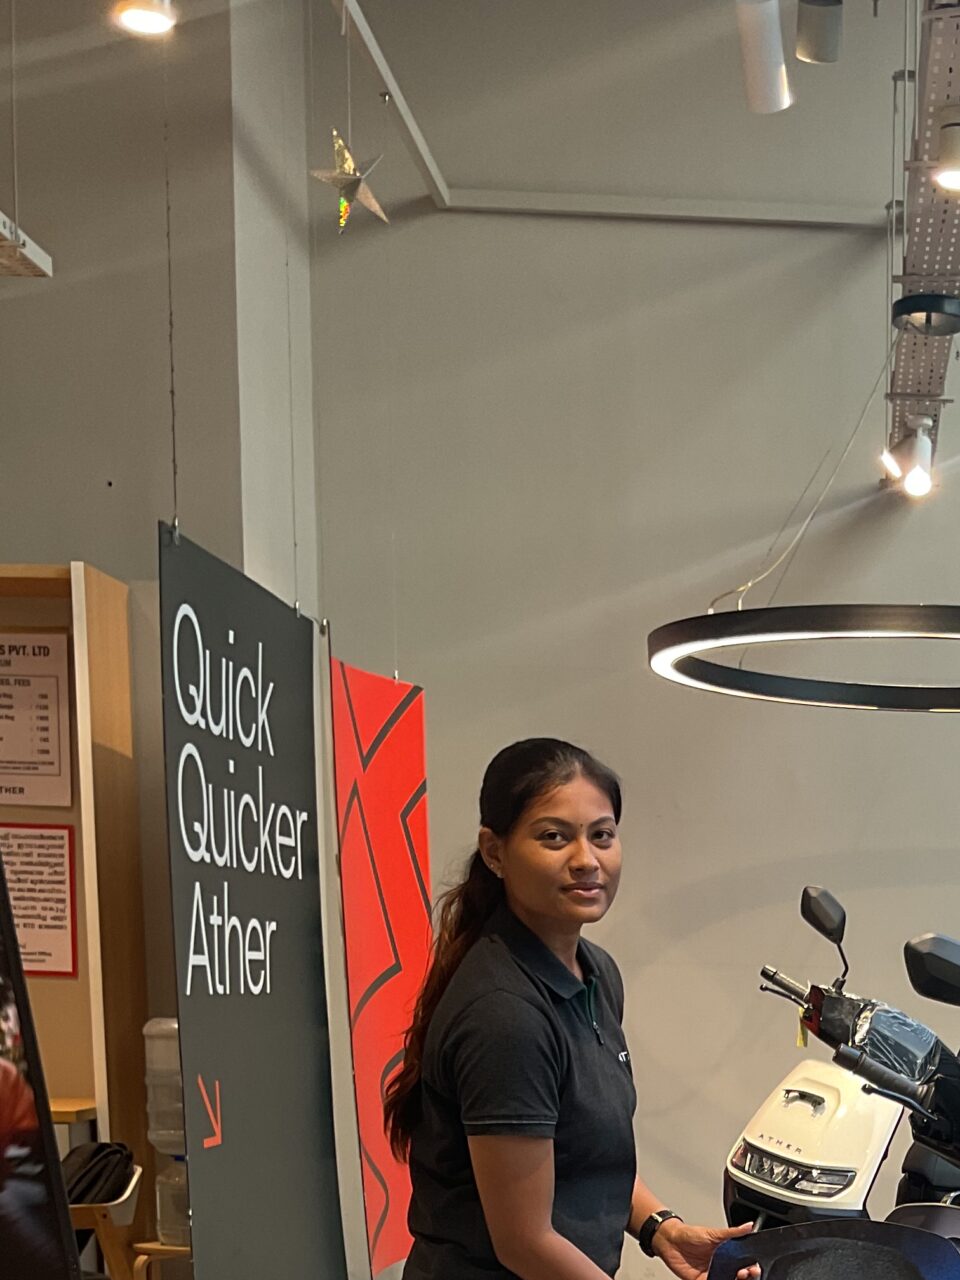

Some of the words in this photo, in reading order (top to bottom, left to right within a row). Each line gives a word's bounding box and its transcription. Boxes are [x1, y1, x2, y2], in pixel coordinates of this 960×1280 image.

[8, 645, 30, 657] PVT.
[32, 645, 50, 657] LTD
[173, 603, 275, 757] Quick
[177, 742, 308, 880] Quicker
[185, 881, 277, 996] Ather
[758, 1133, 802, 1155] ATHER
